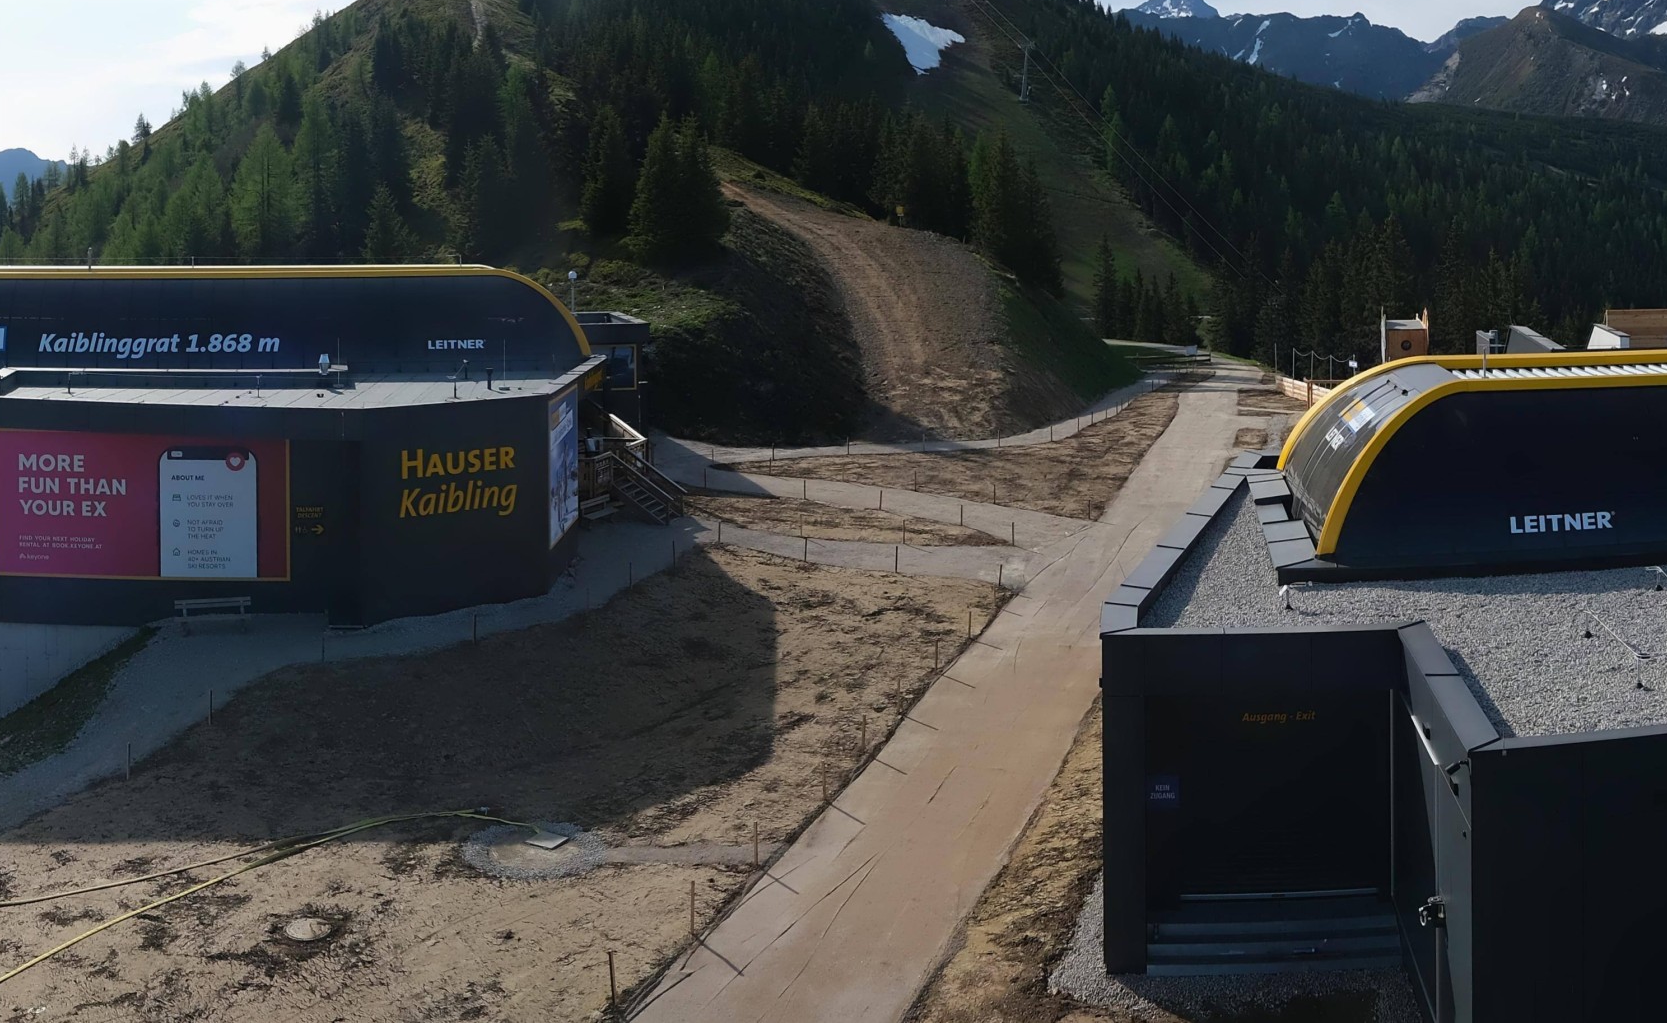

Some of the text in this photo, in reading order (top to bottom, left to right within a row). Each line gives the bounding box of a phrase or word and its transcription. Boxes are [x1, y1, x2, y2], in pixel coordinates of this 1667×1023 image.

[38, 332, 280, 359] Kaiblinggrat 1.868 m
[427, 339, 485, 350] LEITNER
[18, 453, 85, 473] MORE
[401, 446, 516, 480] HAUSER
[18, 476, 127, 495] FUN THAN
[19, 499, 107, 517] YOUR EX
[400, 480, 518, 518] Kaibling
[1509, 511, 1614, 534] LEITNER
[1241, 712, 1288, 725] Ausgang
[1295, 709, 1316, 720] Exit
